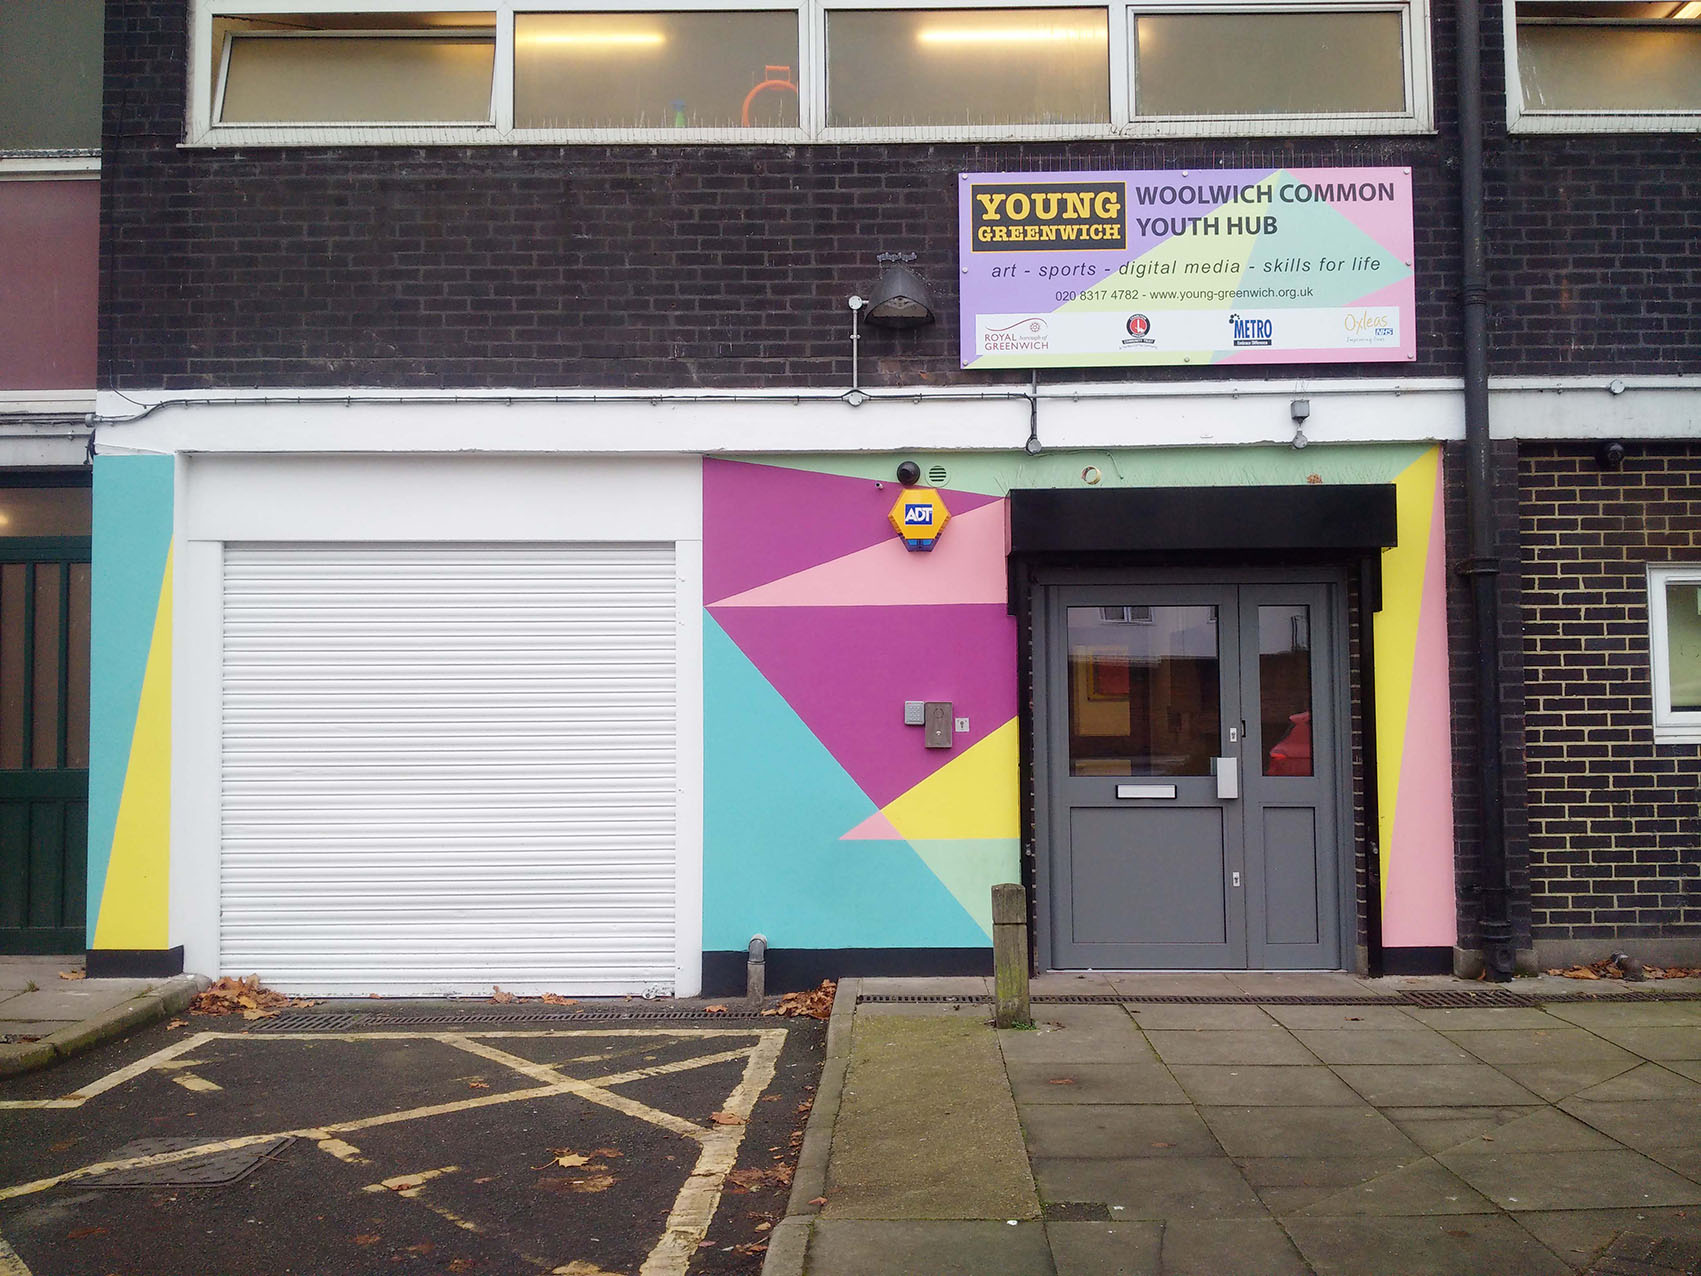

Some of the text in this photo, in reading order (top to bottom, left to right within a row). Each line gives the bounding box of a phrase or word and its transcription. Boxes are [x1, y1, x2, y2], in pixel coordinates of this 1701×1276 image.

[1136, 182, 1395, 205] WOOLWICH COMMON
[976, 191, 1121, 221] YOUNG
[977, 224, 1121, 242] GREENWICH
[1136, 215, 1278, 237] YOUTH HUB
[991, 264, 1017, 278] art
[1038, 262, 1097, 280] sports
[1119, 261, 1177, 279] digital
[1184, 259, 1241, 274] media
[1263, 258, 1312, 273] skills
[1319, 257, 1345, 272] for
[1352, 256, 1382, 271] life
[1055, 290, 1077, 302] 020
[1080, 290, 1107, 301] 8317
[1110, 289, 1139, 300] 4782
[1149, 287, 1314, 302] www.young-greenwich.org.uk
[1233, 319, 1272, 339] METRO
[1344, 310, 1388, 335] Oxleas
[1374, 328, 1393, 336] NHS
[984, 333, 1017, 342] ROYAL
[984, 341, 1049, 351] GREENWICH
[905, 507, 933, 522] ADT
